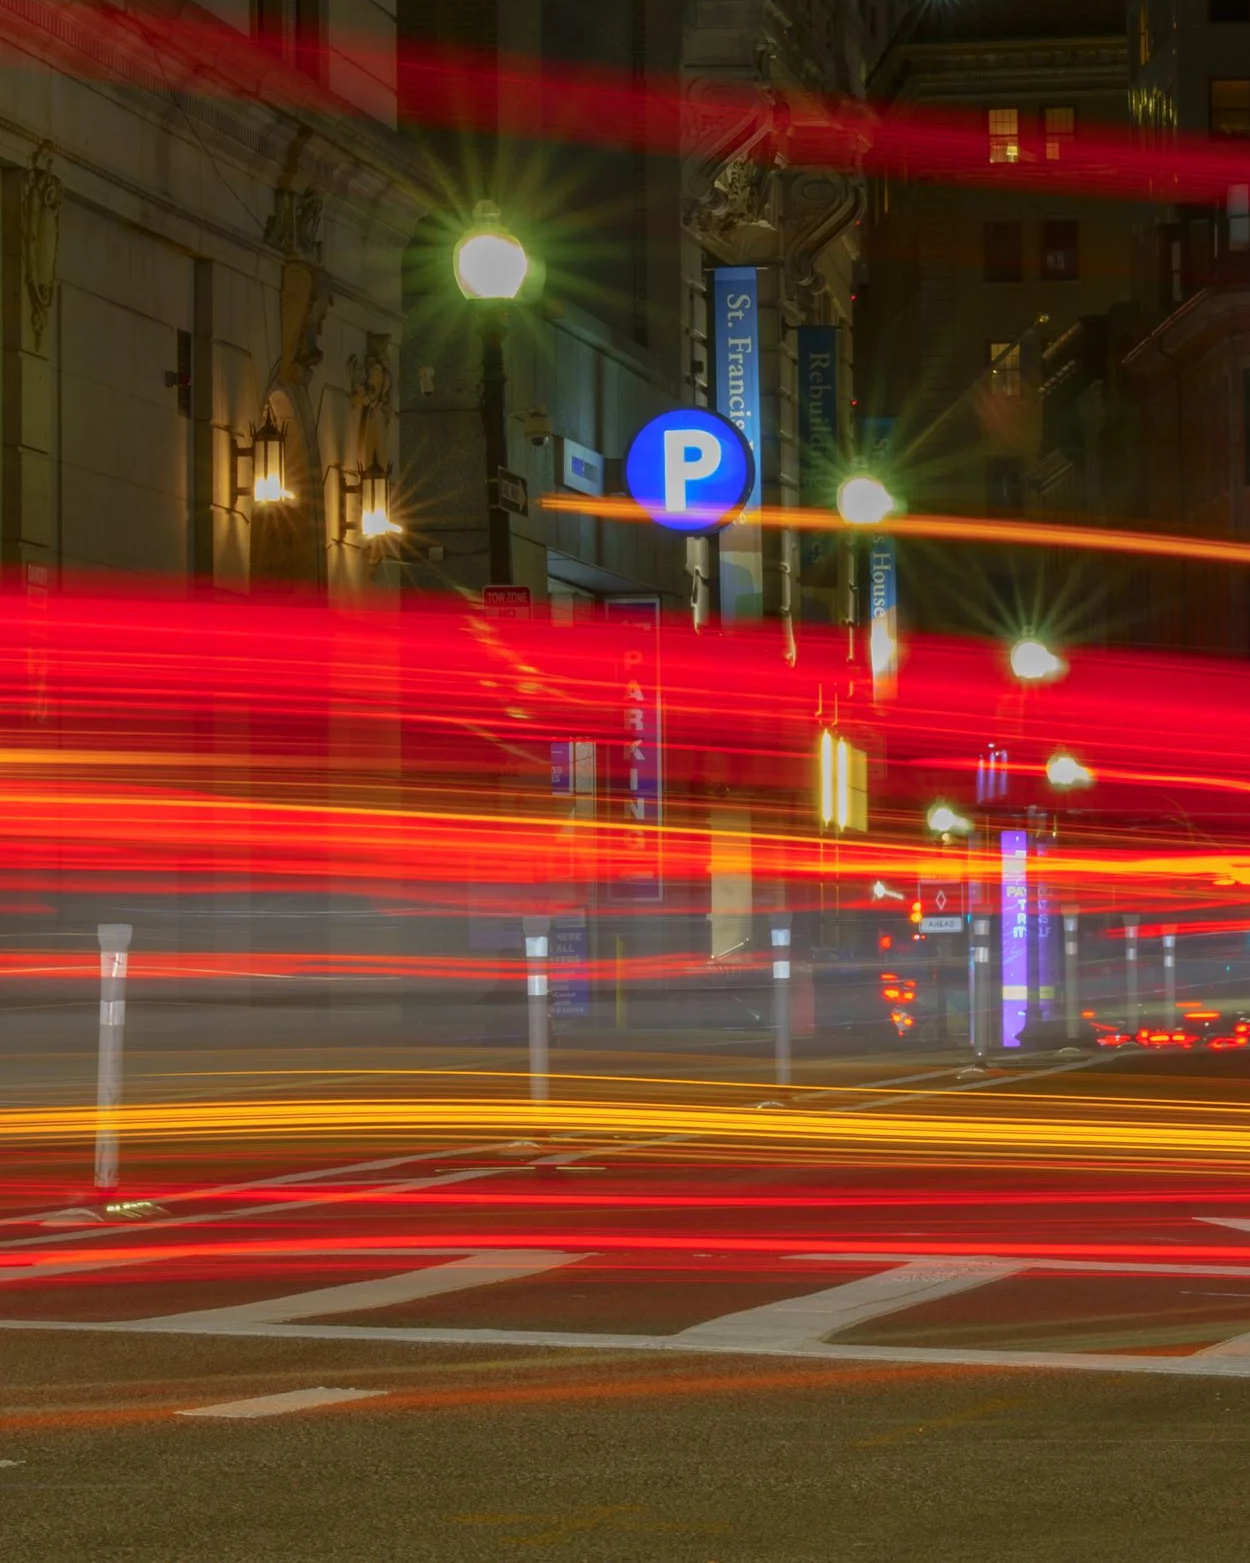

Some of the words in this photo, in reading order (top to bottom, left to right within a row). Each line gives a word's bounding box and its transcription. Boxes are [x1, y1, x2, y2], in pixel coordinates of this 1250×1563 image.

[727, 293, 751, 328] St.
[664, 429, 722, 512] P
[487, 592, 506, 605] TOW
[506, 592, 528, 605] ZONE
[873, 551, 892, 619] House
[623, 649, 645, 850] PARKING
[928, 920, 955, 928] AHEAD
